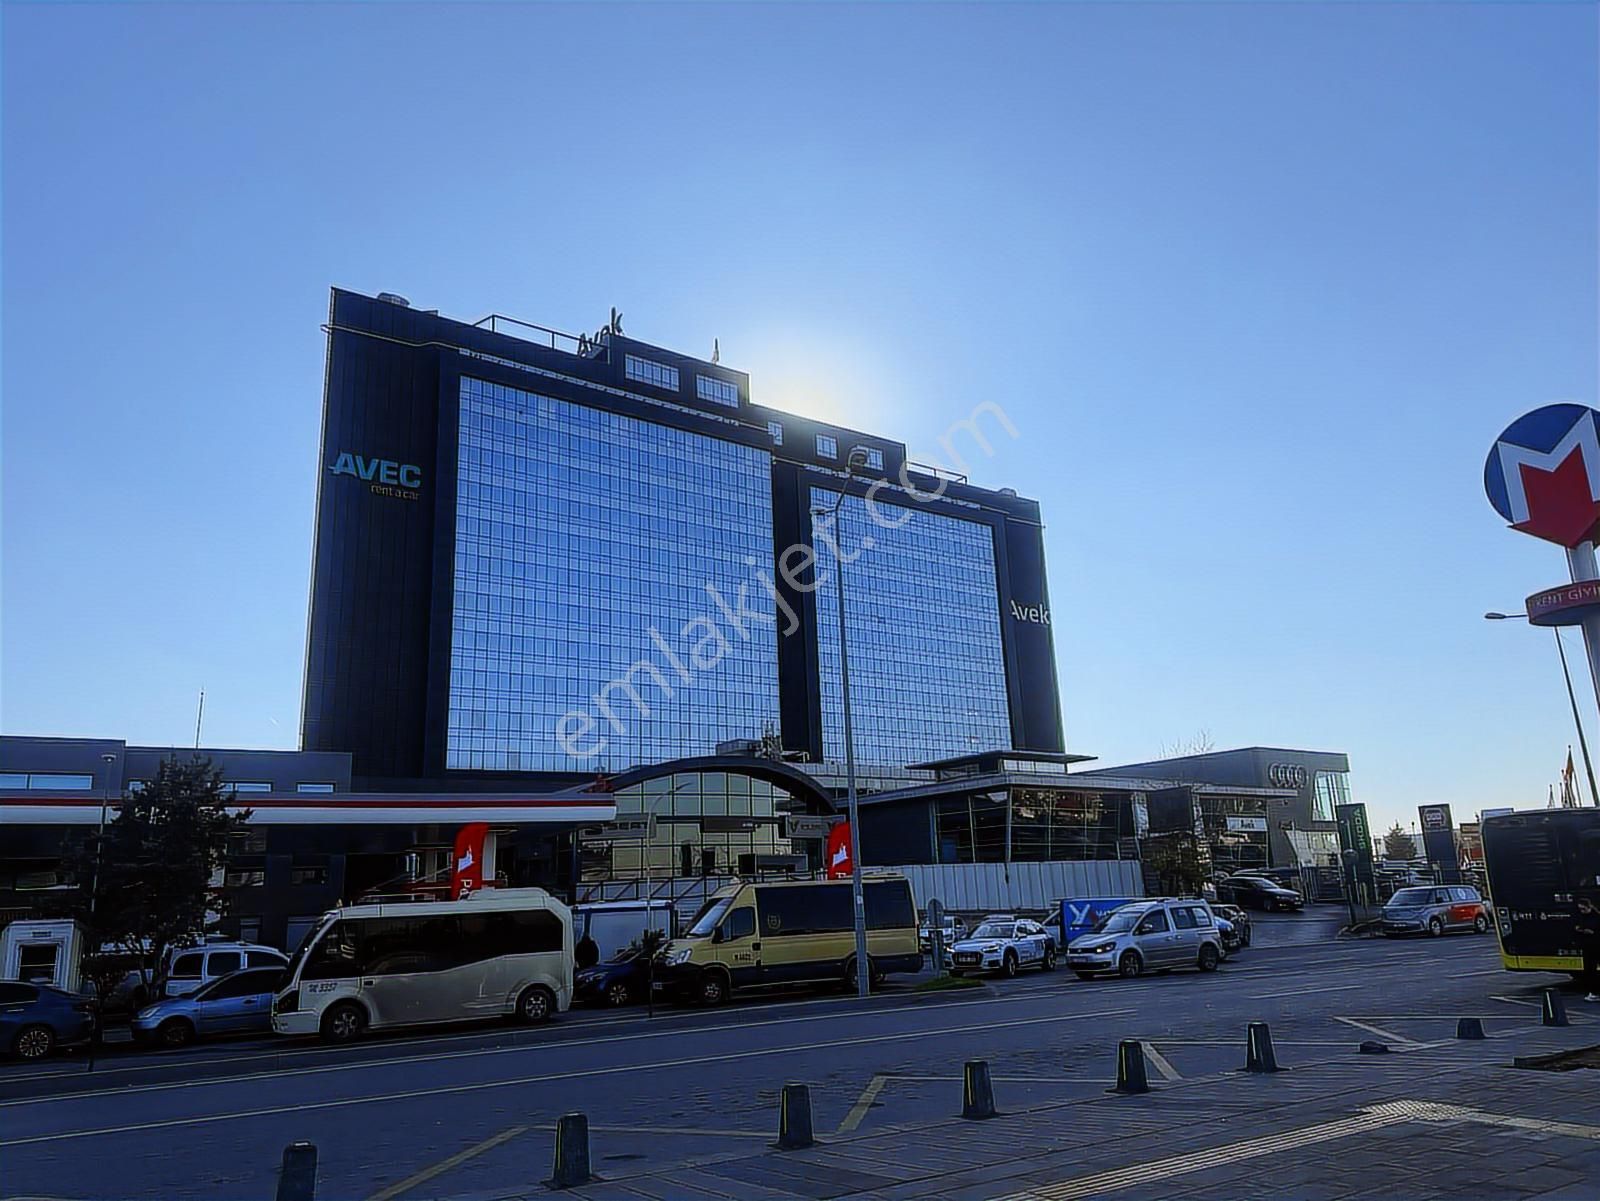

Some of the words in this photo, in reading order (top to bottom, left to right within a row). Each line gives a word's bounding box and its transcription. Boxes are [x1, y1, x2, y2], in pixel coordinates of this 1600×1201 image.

[328, 452, 421, 488] AVEC
[371, 484, 393, 496] rent
[403, 491, 420, 500] car
[1011, 599, 1050, 625] Avek
